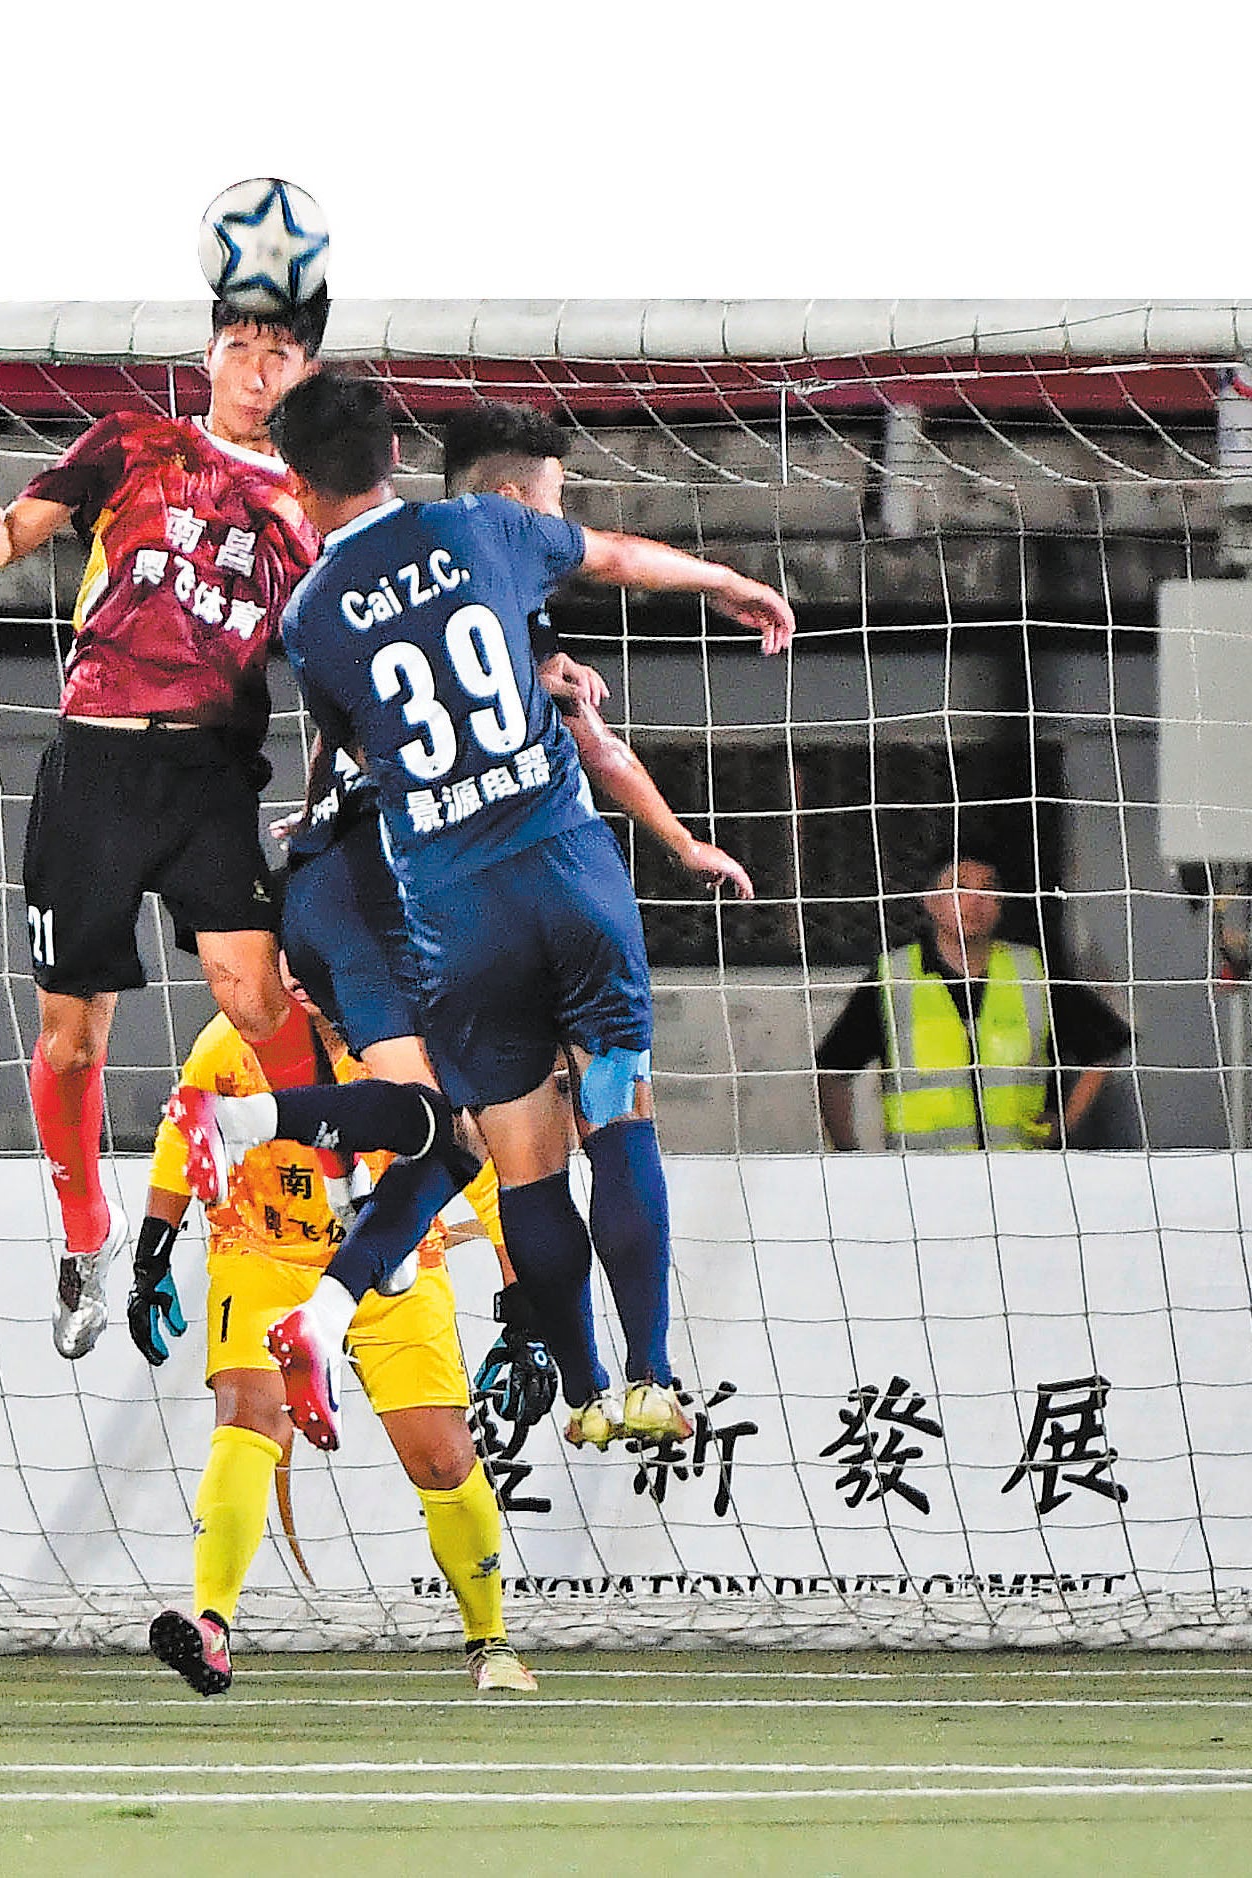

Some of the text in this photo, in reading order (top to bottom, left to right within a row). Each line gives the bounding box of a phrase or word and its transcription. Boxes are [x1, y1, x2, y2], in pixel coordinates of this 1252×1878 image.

[165, 505, 257, 578] 南昌
[131, 549, 267, 641] 奥飞体育
[341, 548, 471, 632] Cai Z.C.
[370, 603, 528, 781] 39
[405, 742, 551, 833] 景源电器
[276, 1163, 315, 1200] 南
[220, 1295, 233, 1344] 1
